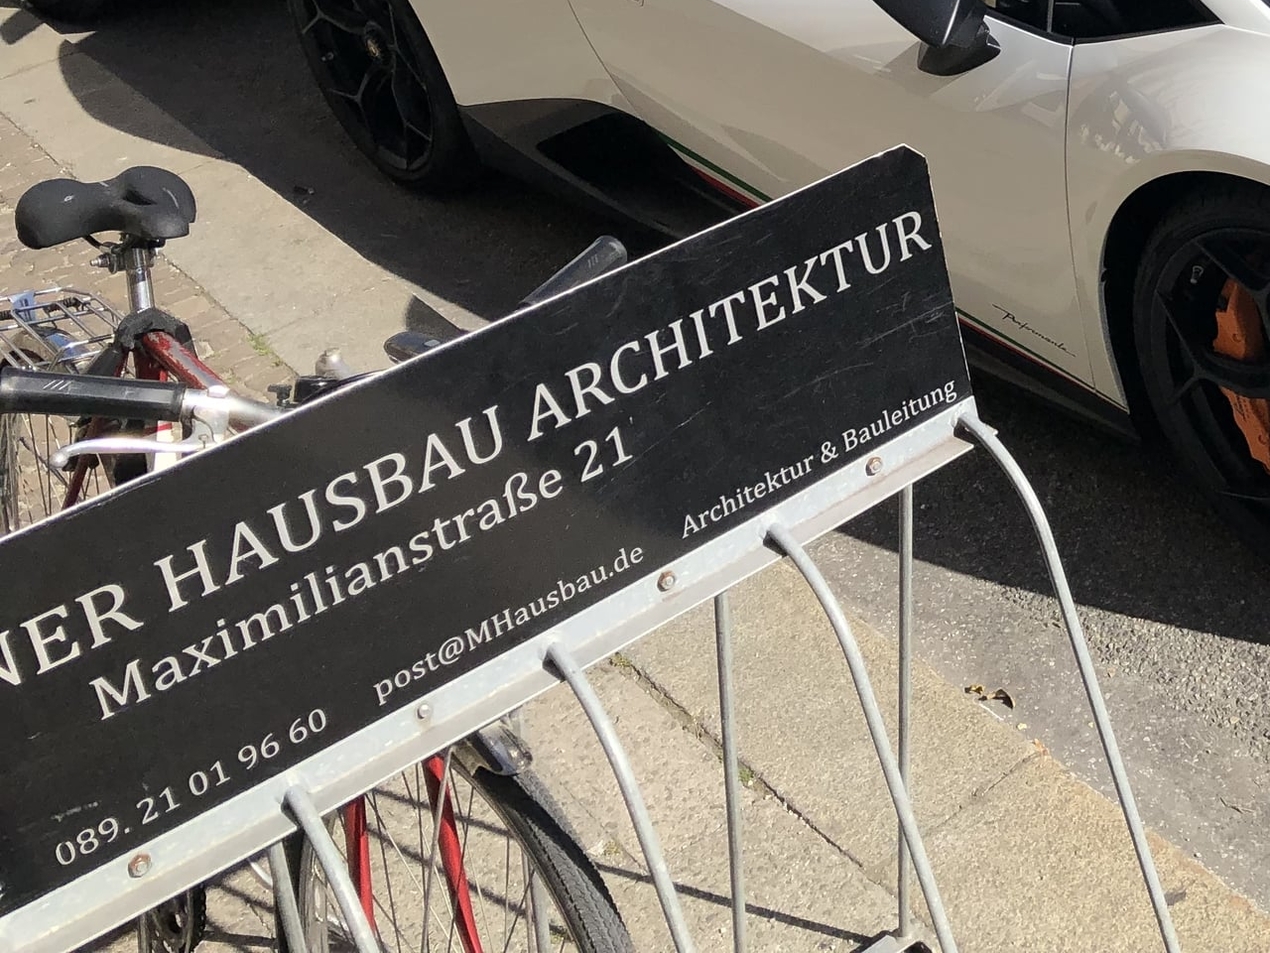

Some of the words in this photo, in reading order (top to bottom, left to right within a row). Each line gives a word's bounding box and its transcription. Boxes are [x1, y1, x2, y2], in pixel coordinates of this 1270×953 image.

[153, 404, 503, 614] HAUSBAU
[527, 210, 933, 442] ARCHITEKTUR
[681, 454, 815, 540] Architektur
[819, 441, 839, 464] &
[841, 379, 958, 452] Bauleitung
[89, 470, 564, 721] Maximilianstraße
[573, 425, 634, 484] 21
[372, 546, 645, 707] post@MHausbau.de
[54, 817, 132, 867] 089.
[135, 785, 182, 826] 21
[188, 759, 232, 797] 01
[237, 732, 281, 771] 96
[288, 707, 328, 745] 60
